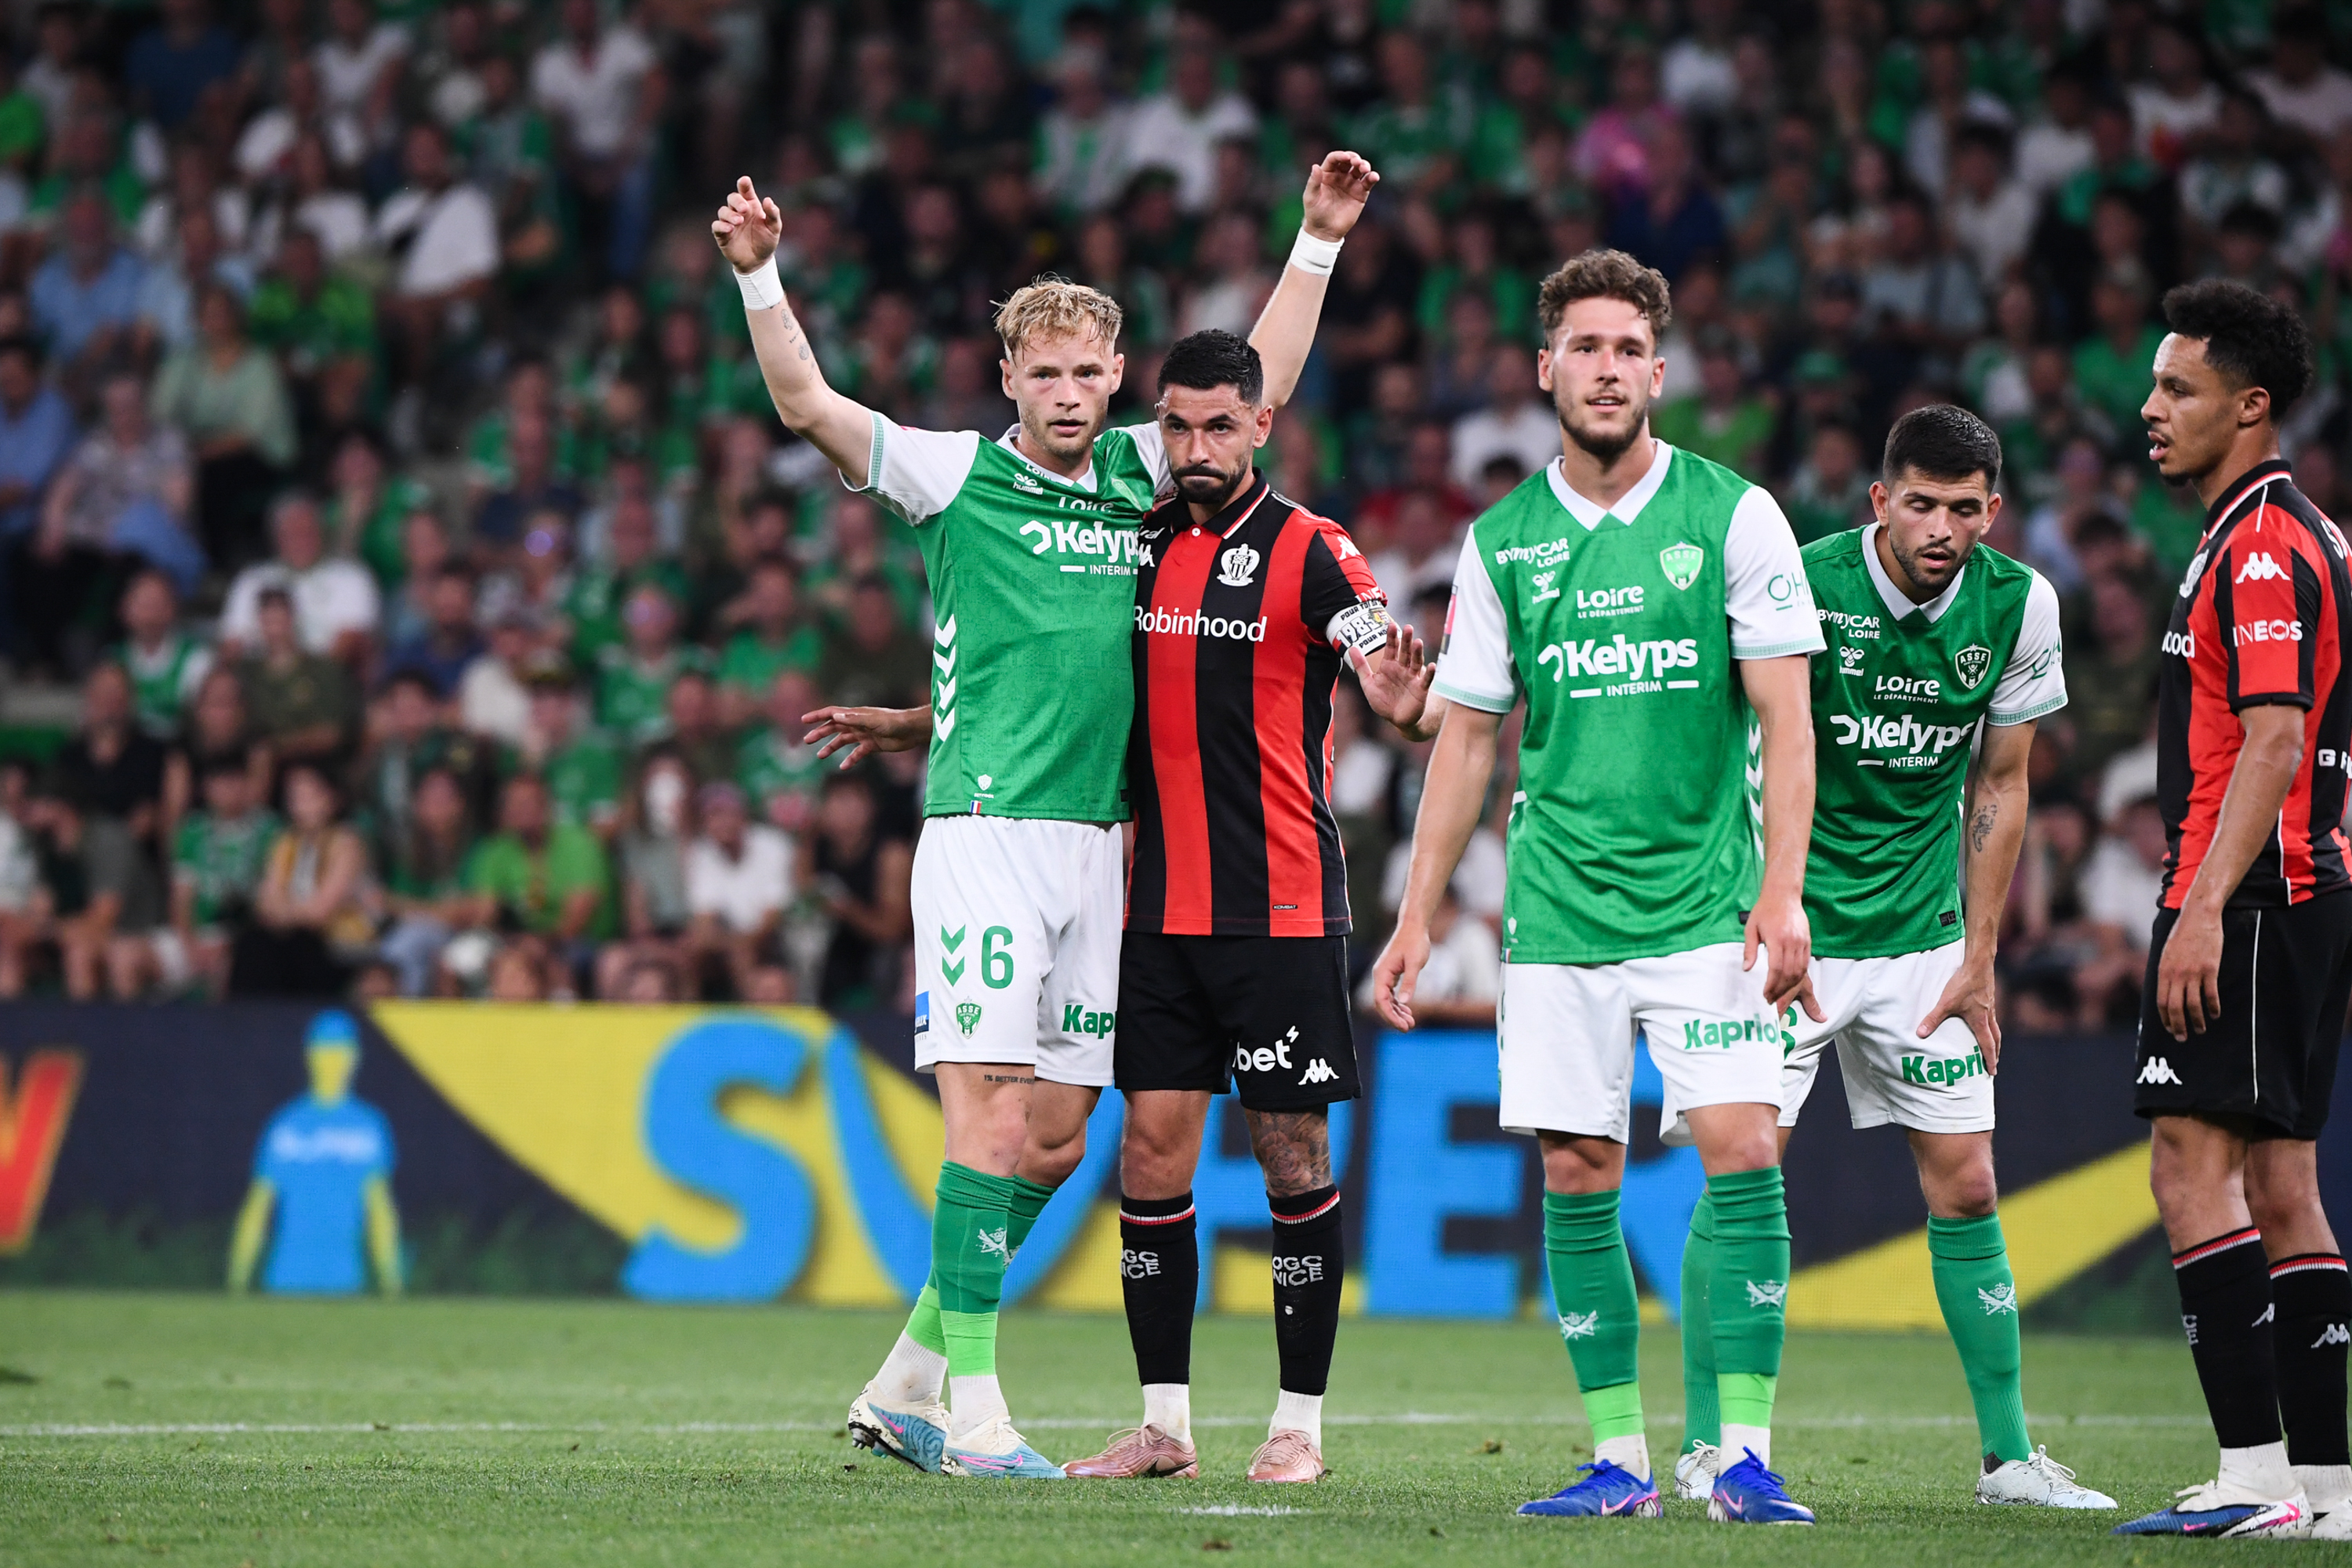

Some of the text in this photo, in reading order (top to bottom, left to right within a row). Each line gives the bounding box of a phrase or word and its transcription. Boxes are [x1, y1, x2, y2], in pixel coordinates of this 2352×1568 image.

[1012, 481, 1044, 495] hummel
[1537, 551, 1570, 568] LOIRE
[1666, 550, 1697, 561] ASSE
[1089, 564, 1131, 575] INTERIM
[1340, 605, 1359, 621] POUR
[1589, 605, 1644, 618] DÉPARTEMENT
[1134, 605, 1267, 642] Robinhood
[1359, 633, 1377, 648] POUR
[1849, 629, 1880, 639] LOIRE
[2233, 619, 2303, 647] INEOS
[1563, 633, 1698, 681] Kelyps
[1960, 652, 1987, 664] ASSE
[1606, 680, 1662, 697] INTERIM
[1884, 693, 1939, 704] DÉPARTEMENT
[1888, 757, 1938, 768] INTERIM
[982, 925, 1014, 989] 6
[957, 1005, 980, 1014] ASSE
[1062, 1004, 1116, 1040] Kap
[1232, 1039, 1293, 1073] bet
[1901, 1045, 1990, 1087] Kapri
[1272, 1255, 1323, 1270] OGC
[1272, 1266, 1324, 1287] NICE
